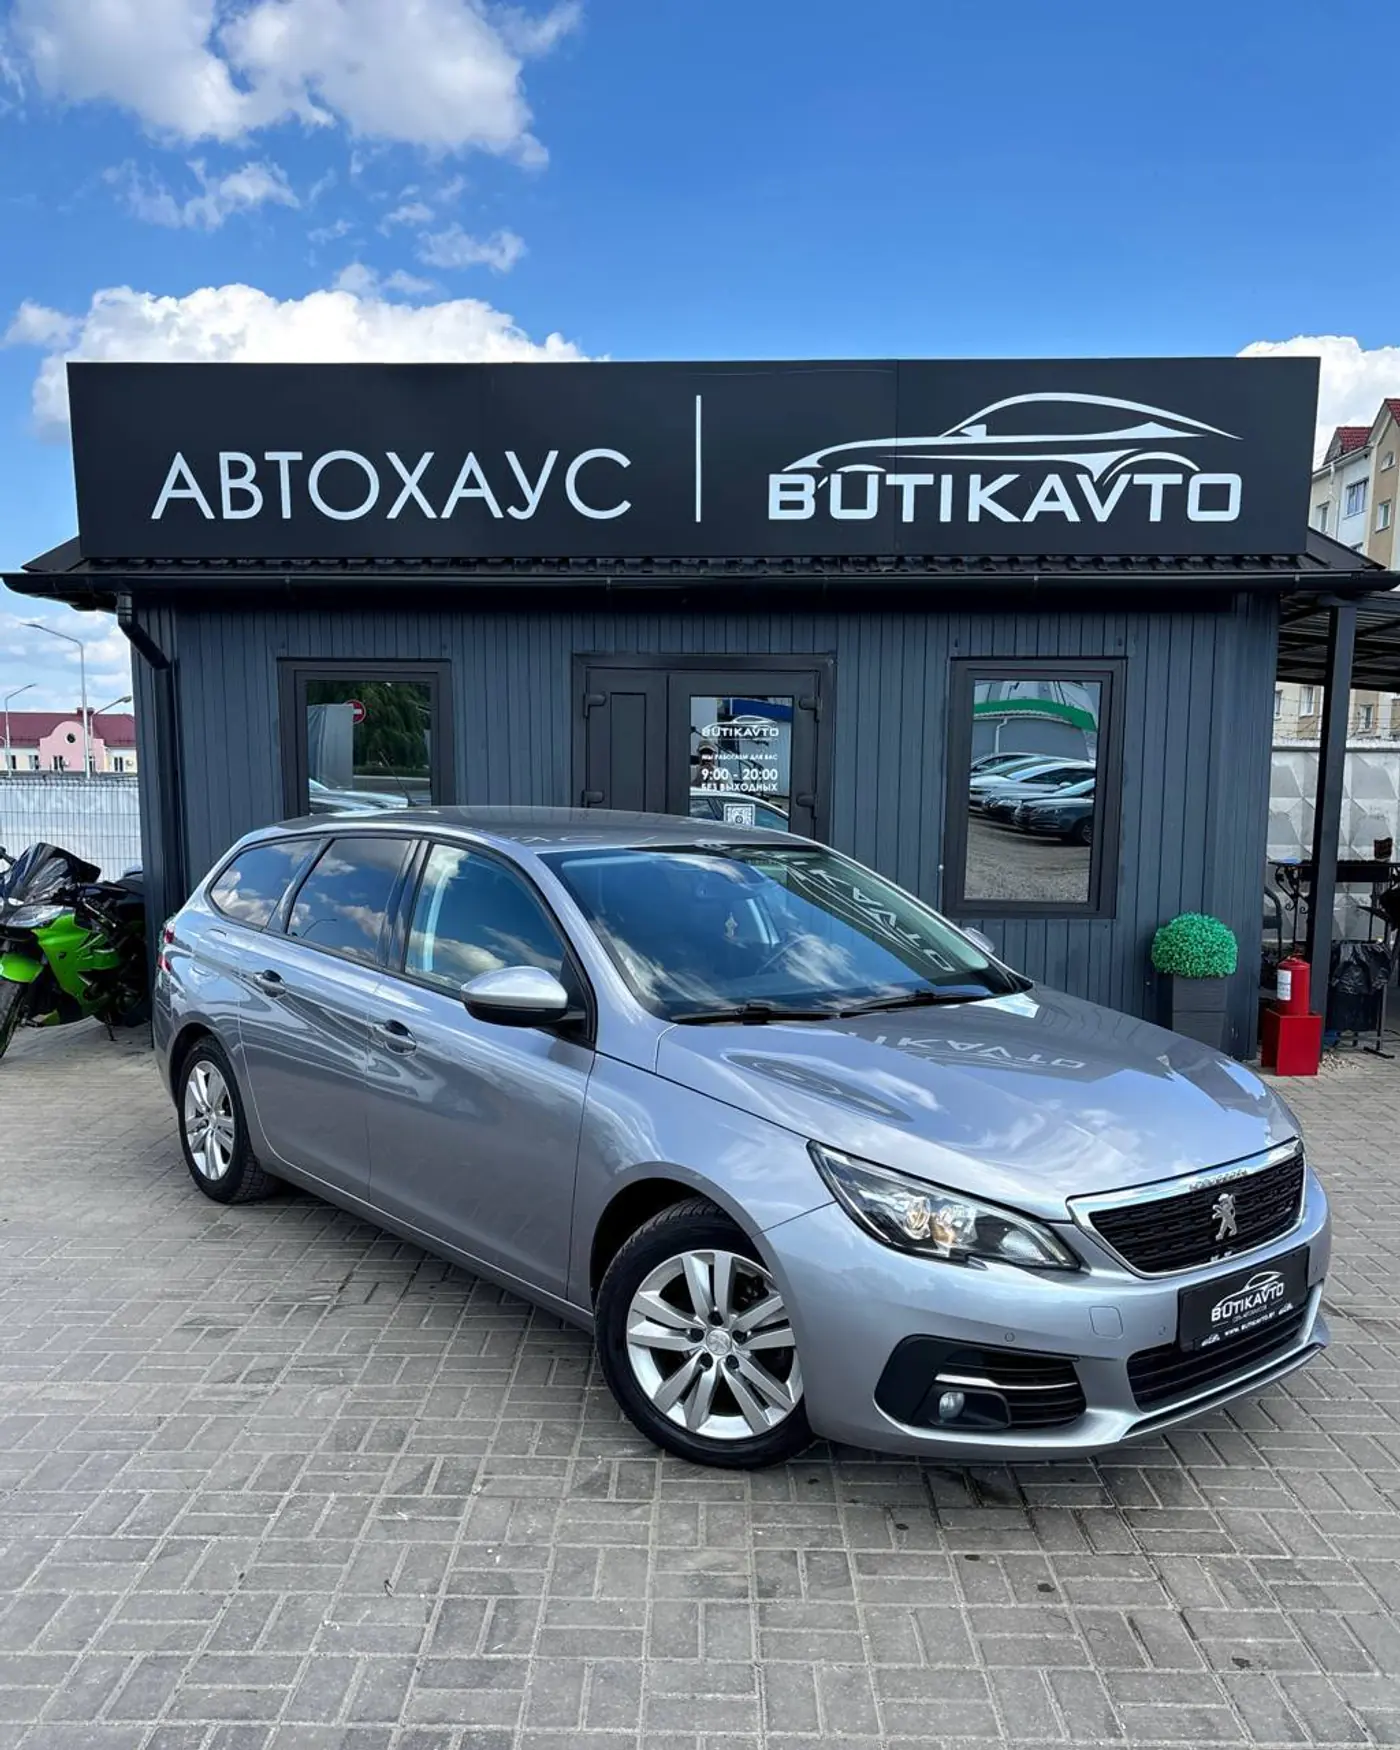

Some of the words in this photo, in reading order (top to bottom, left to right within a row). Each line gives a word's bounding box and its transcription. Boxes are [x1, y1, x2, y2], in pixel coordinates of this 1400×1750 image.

[151, 448, 631, 521] АВТОХАУС
[768, 472, 1242, 523] BUTIKAVTO
[701, 727, 779, 737] BUTIKAVTO
[701, 768, 729, 781] 9:00
[742, 768, 778, 781] 20:00
[701, 783, 717, 792] БЕЗ
[720, 783, 778, 792] ВЫХОДНЫХ
[1211, 1282, 1284, 1322] BUTIKAVTO
